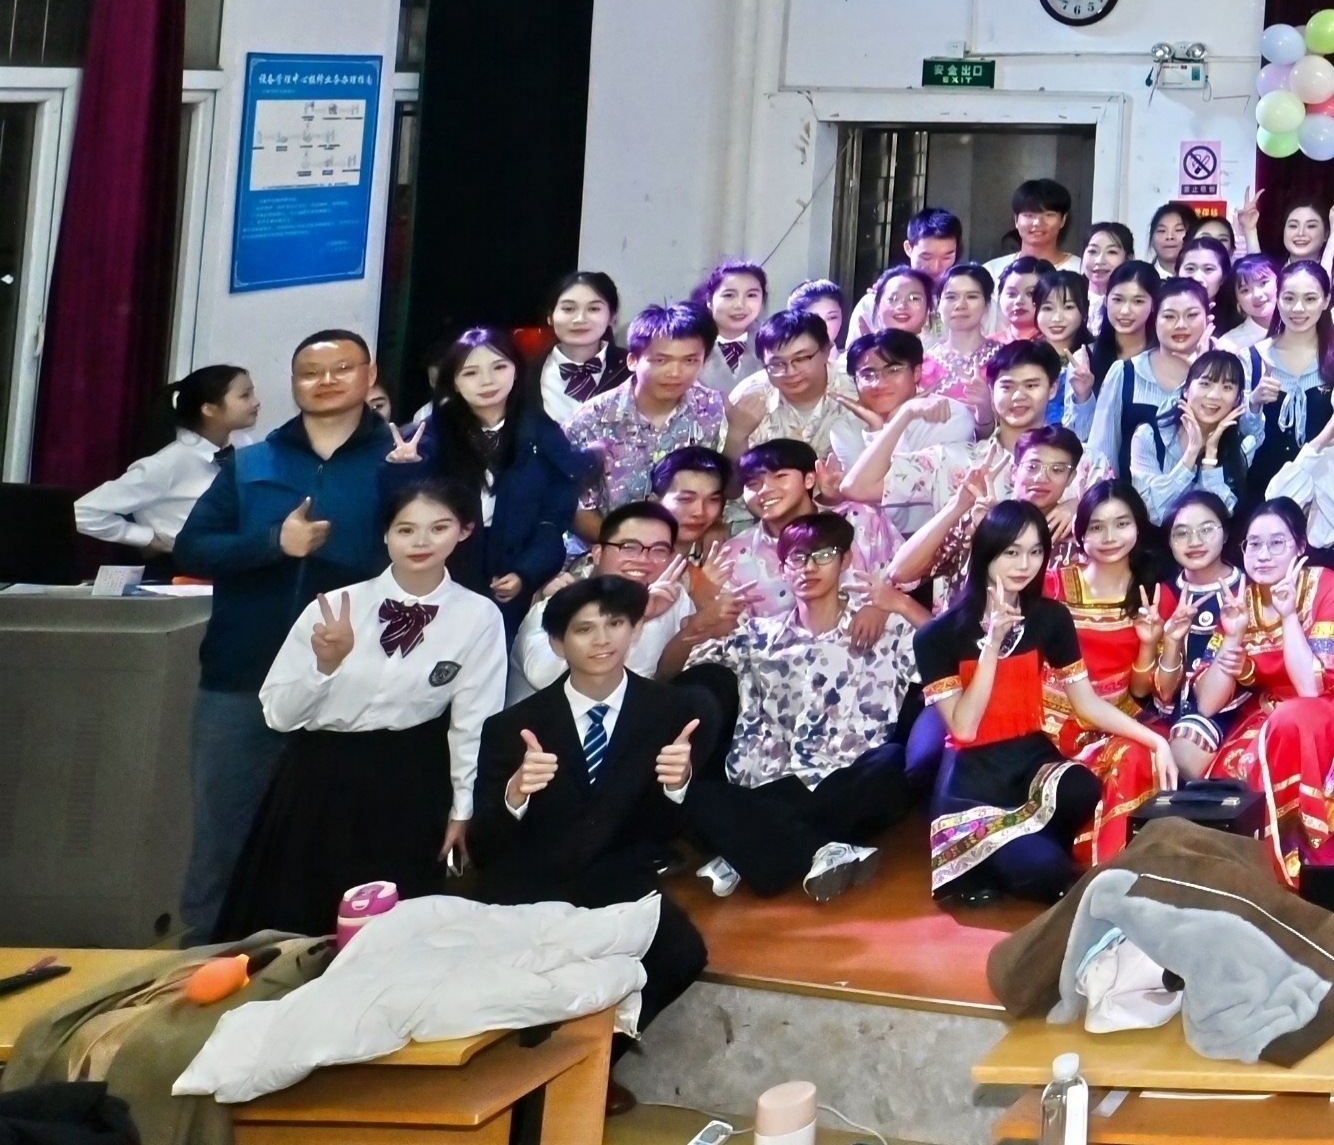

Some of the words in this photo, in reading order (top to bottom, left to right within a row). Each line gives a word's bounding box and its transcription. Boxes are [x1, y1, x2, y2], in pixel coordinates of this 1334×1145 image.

[1073, 4, 1081, 15] 6
[1087, 2, 1095, 12] 5
[933, 64, 983, 77] 安全出口
[942, 76, 973, 84] EXIT
